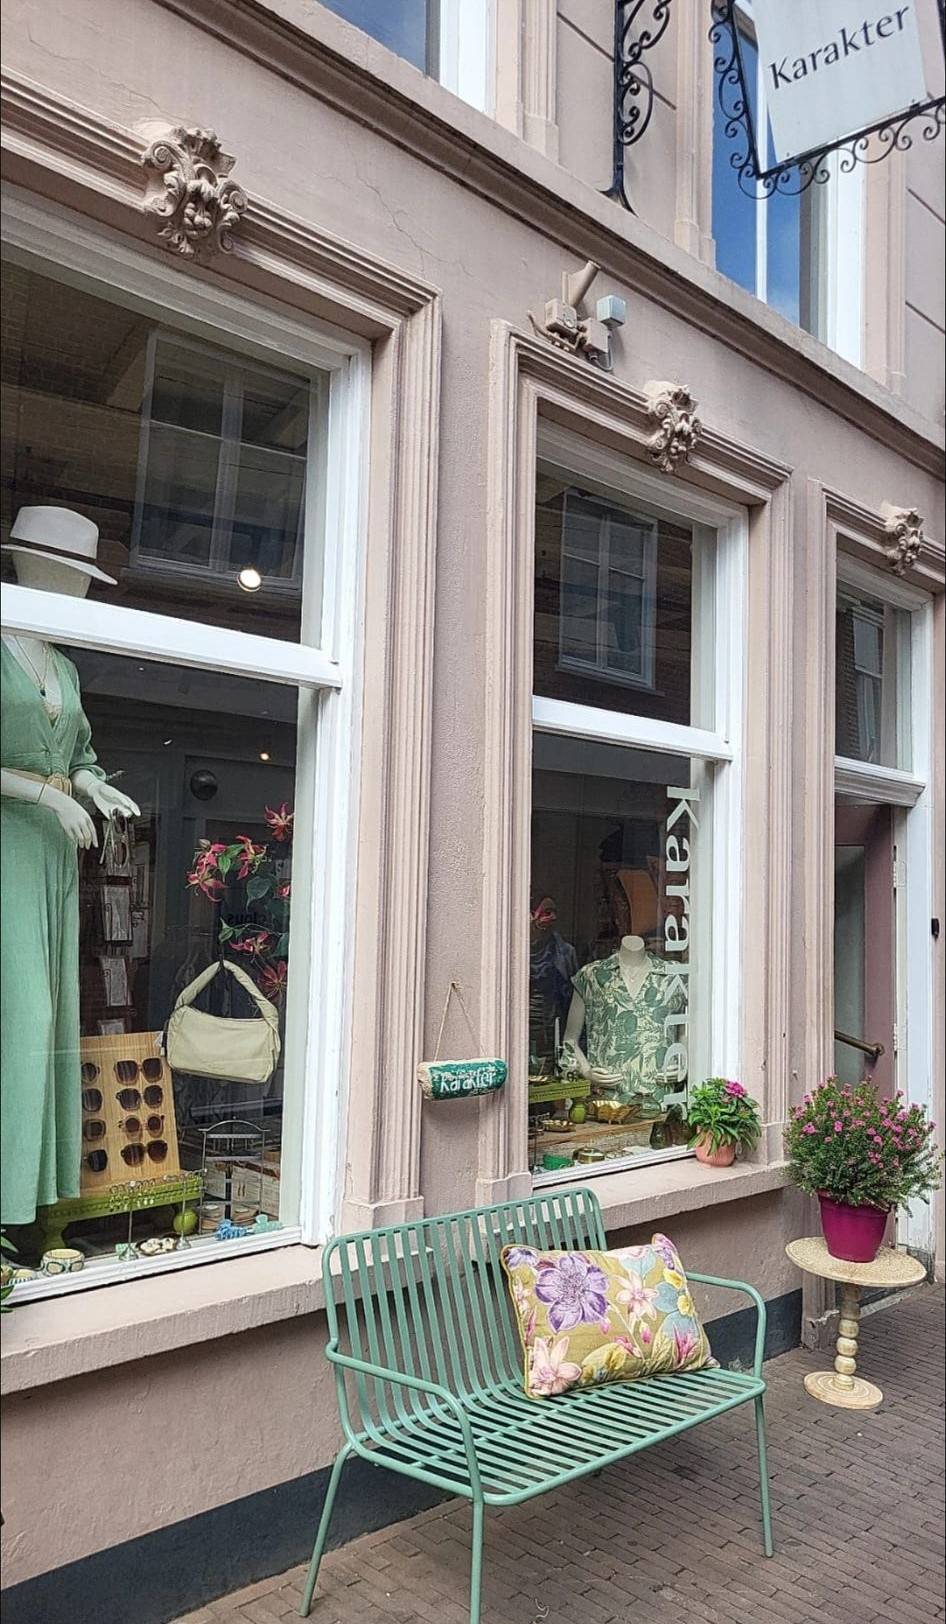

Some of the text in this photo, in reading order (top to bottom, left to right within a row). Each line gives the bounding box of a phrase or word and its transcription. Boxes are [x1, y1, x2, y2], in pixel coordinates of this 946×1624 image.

[768, 6, 910, 90] Karakter
[664, 786, 701, 1121] Karakter
[440, 1067, 497, 1092] Karakter
